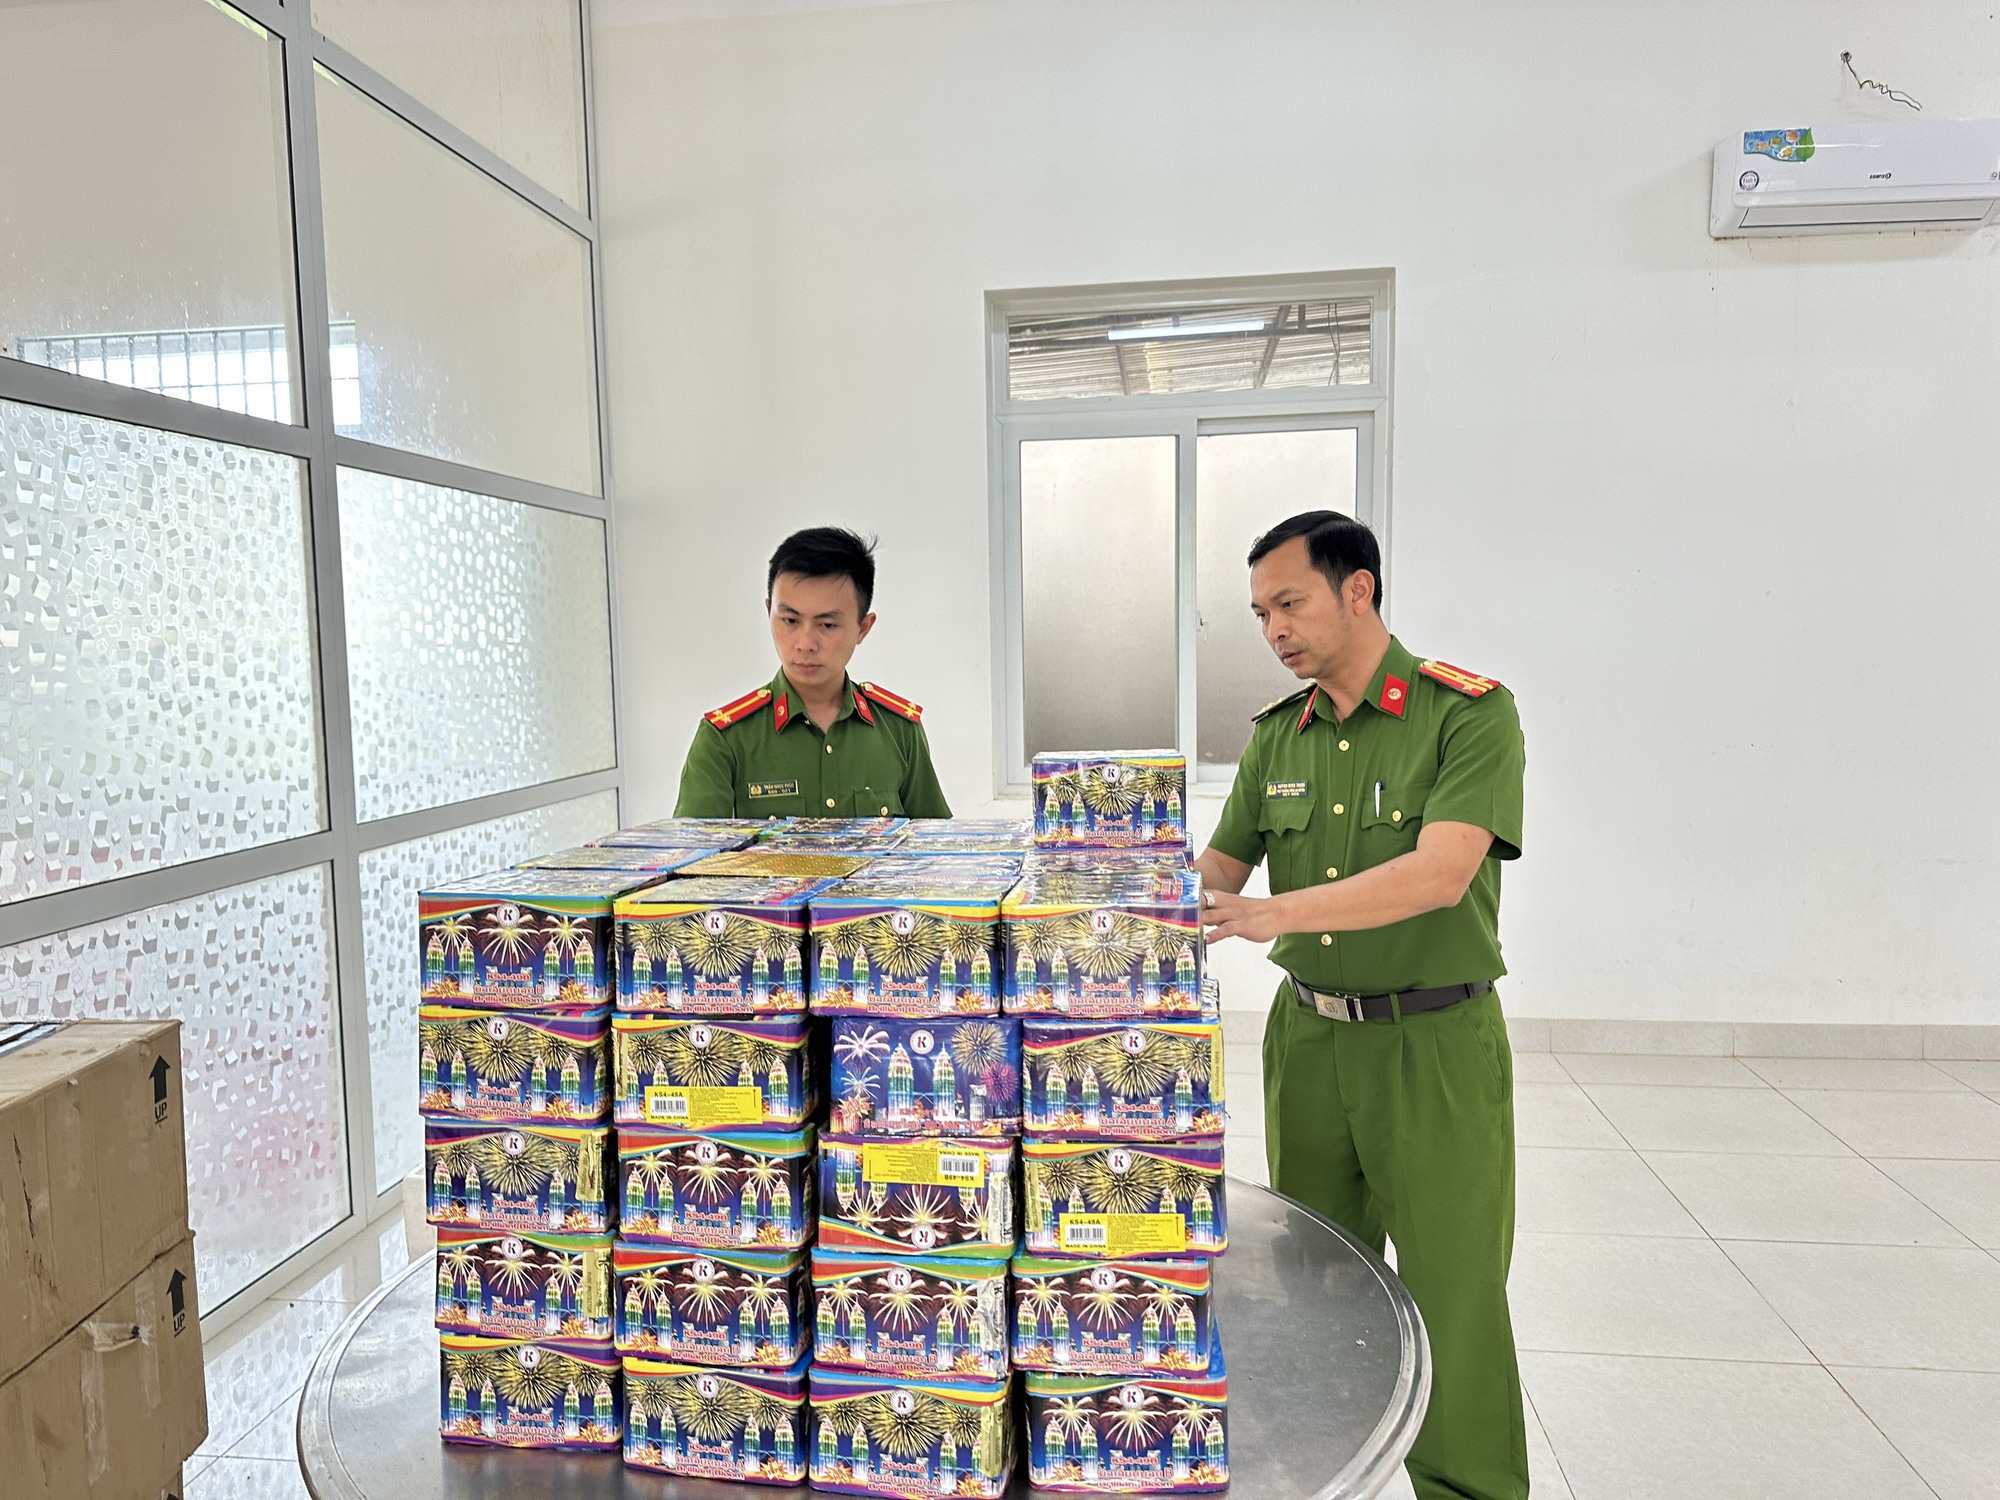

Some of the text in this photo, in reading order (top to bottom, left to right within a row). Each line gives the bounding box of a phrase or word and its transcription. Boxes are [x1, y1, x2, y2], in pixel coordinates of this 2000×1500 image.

[503, 909, 513, 921] K
[710, 916, 720, 929] K
[899, 916, 908, 929] K
[1097, 916, 1107, 929] K
[695, 982, 740, 991] KS4-49A
[882, 982, 927, 991] KS4-49A
[1082, 982, 1129, 992] KS4-49A
[682, 1005, 754, 1014] Brilliant Bloom
[867, 1004, 940, 1015] Brilliant Bloom
[1068, 1006, 1145, 1015] Brilliant Bloom
[493, 1022, 502, 1035] K
[695, 1030, 705, 1043] K
[918, 1036, 926, 1049] K
[1129, 1035, 1138, 1048] K
[155, 1101, 167, 1119] UP
[1114, 1104, 1161, 1112] KS4-49A
[1100, 1127, 1140, 1135] Brilliant
[509, 1137, 519, 1150] K
[701, 1146, 711, 1159] K
[1114, 1155, 1124, 1168] K
[710, 1236, 741, 1246] Bloom
[919, 1230, 928, 1243] K
[508, 1243, 516, 1254] K
[698, 1264, 708, 1277] K
[895, 1273, 904, 1286] K
[1098, 1273, 1108, 1285] K
[173, 1312, 185, 1332] UP
[524, 1351, 534, 1363] K
[702, 1380, 712, 1392] K
[897, 1396, 906, 1409] K
[1127, 1390, 1137, 1403] K
[714, 1469, 745, 1480] Bloom
[1140, 1480, 1175, 1489] Bloom
